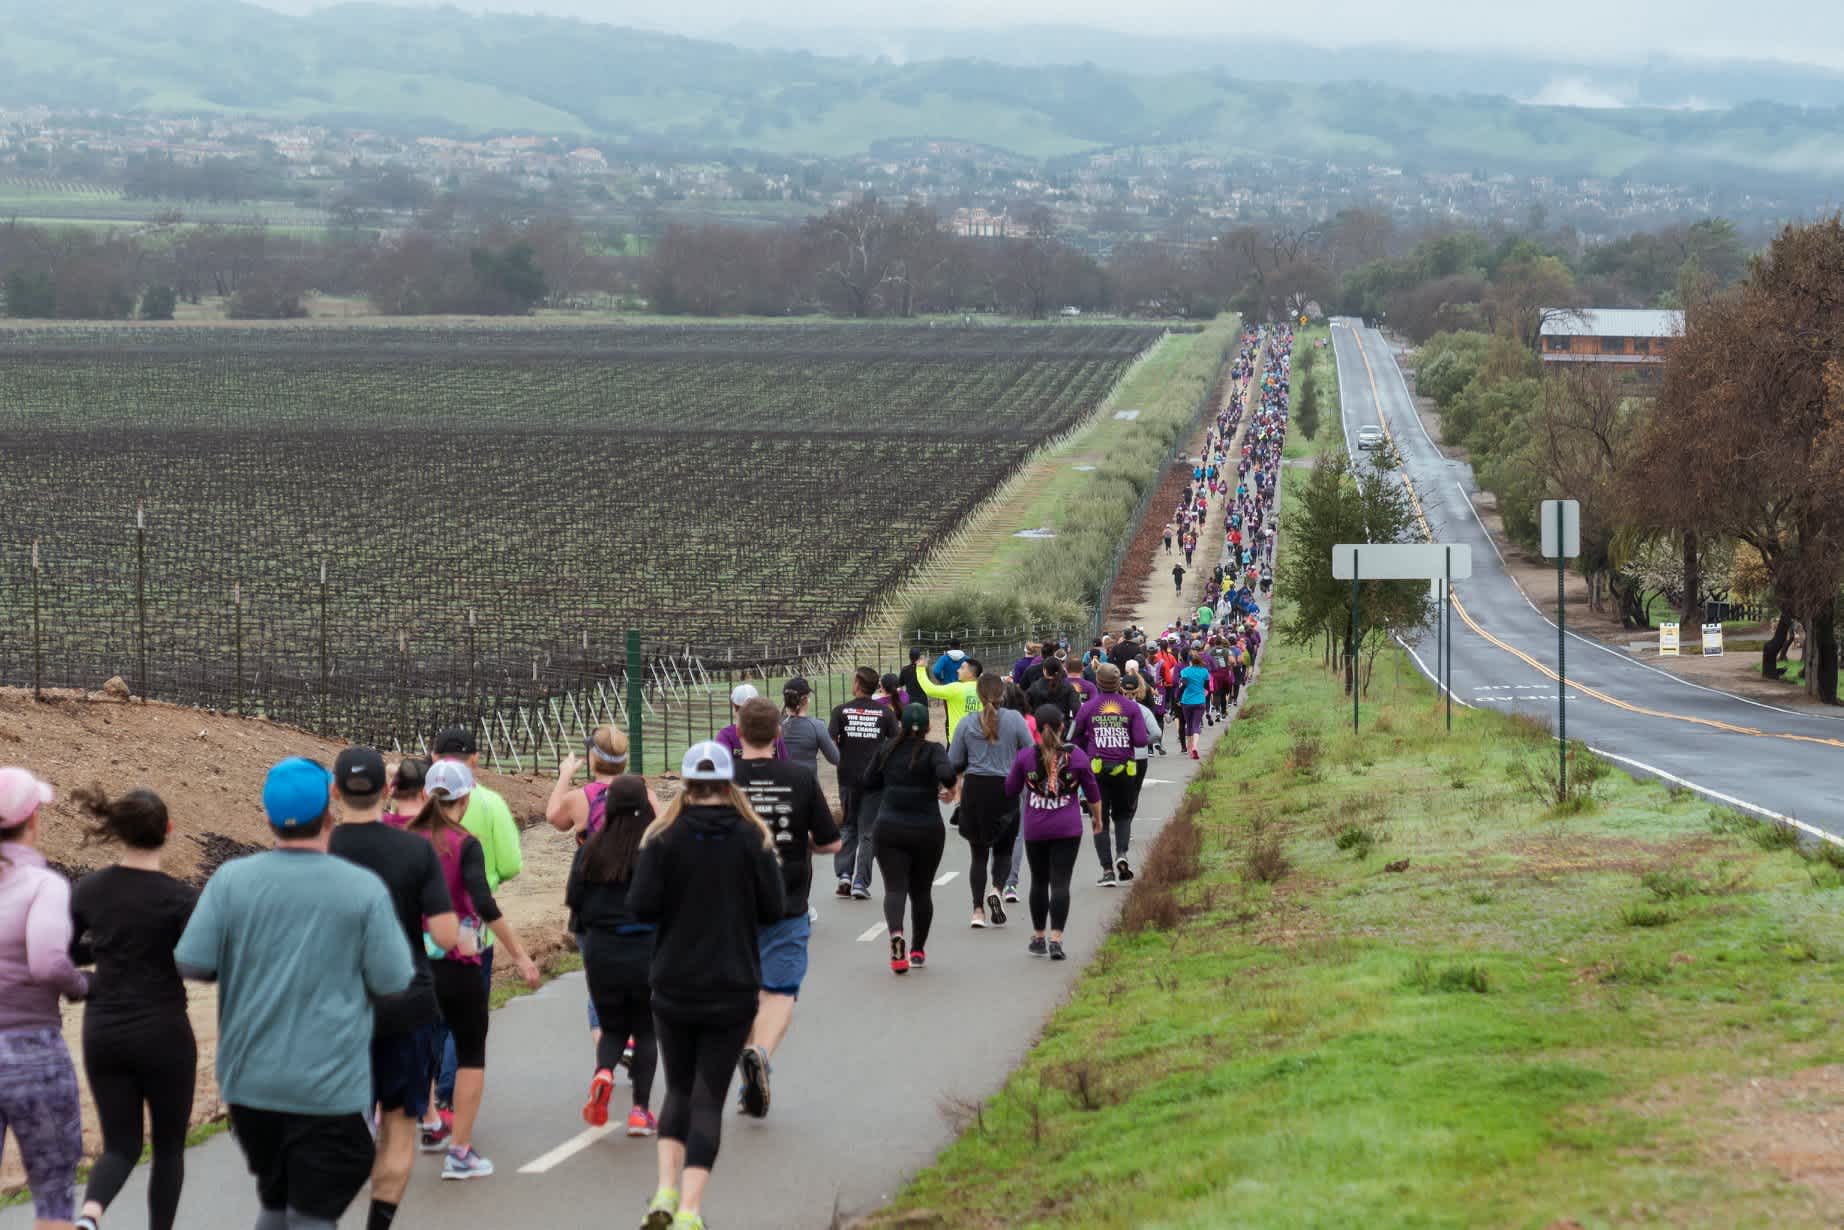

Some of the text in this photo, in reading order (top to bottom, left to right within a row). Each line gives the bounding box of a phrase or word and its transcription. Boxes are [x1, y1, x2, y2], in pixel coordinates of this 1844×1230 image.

[1091, 715, 1118, 723] FOLLOW
[1094, 728, 1129, 737] FINISH
[1095, 736, 1130, 748] WINE
